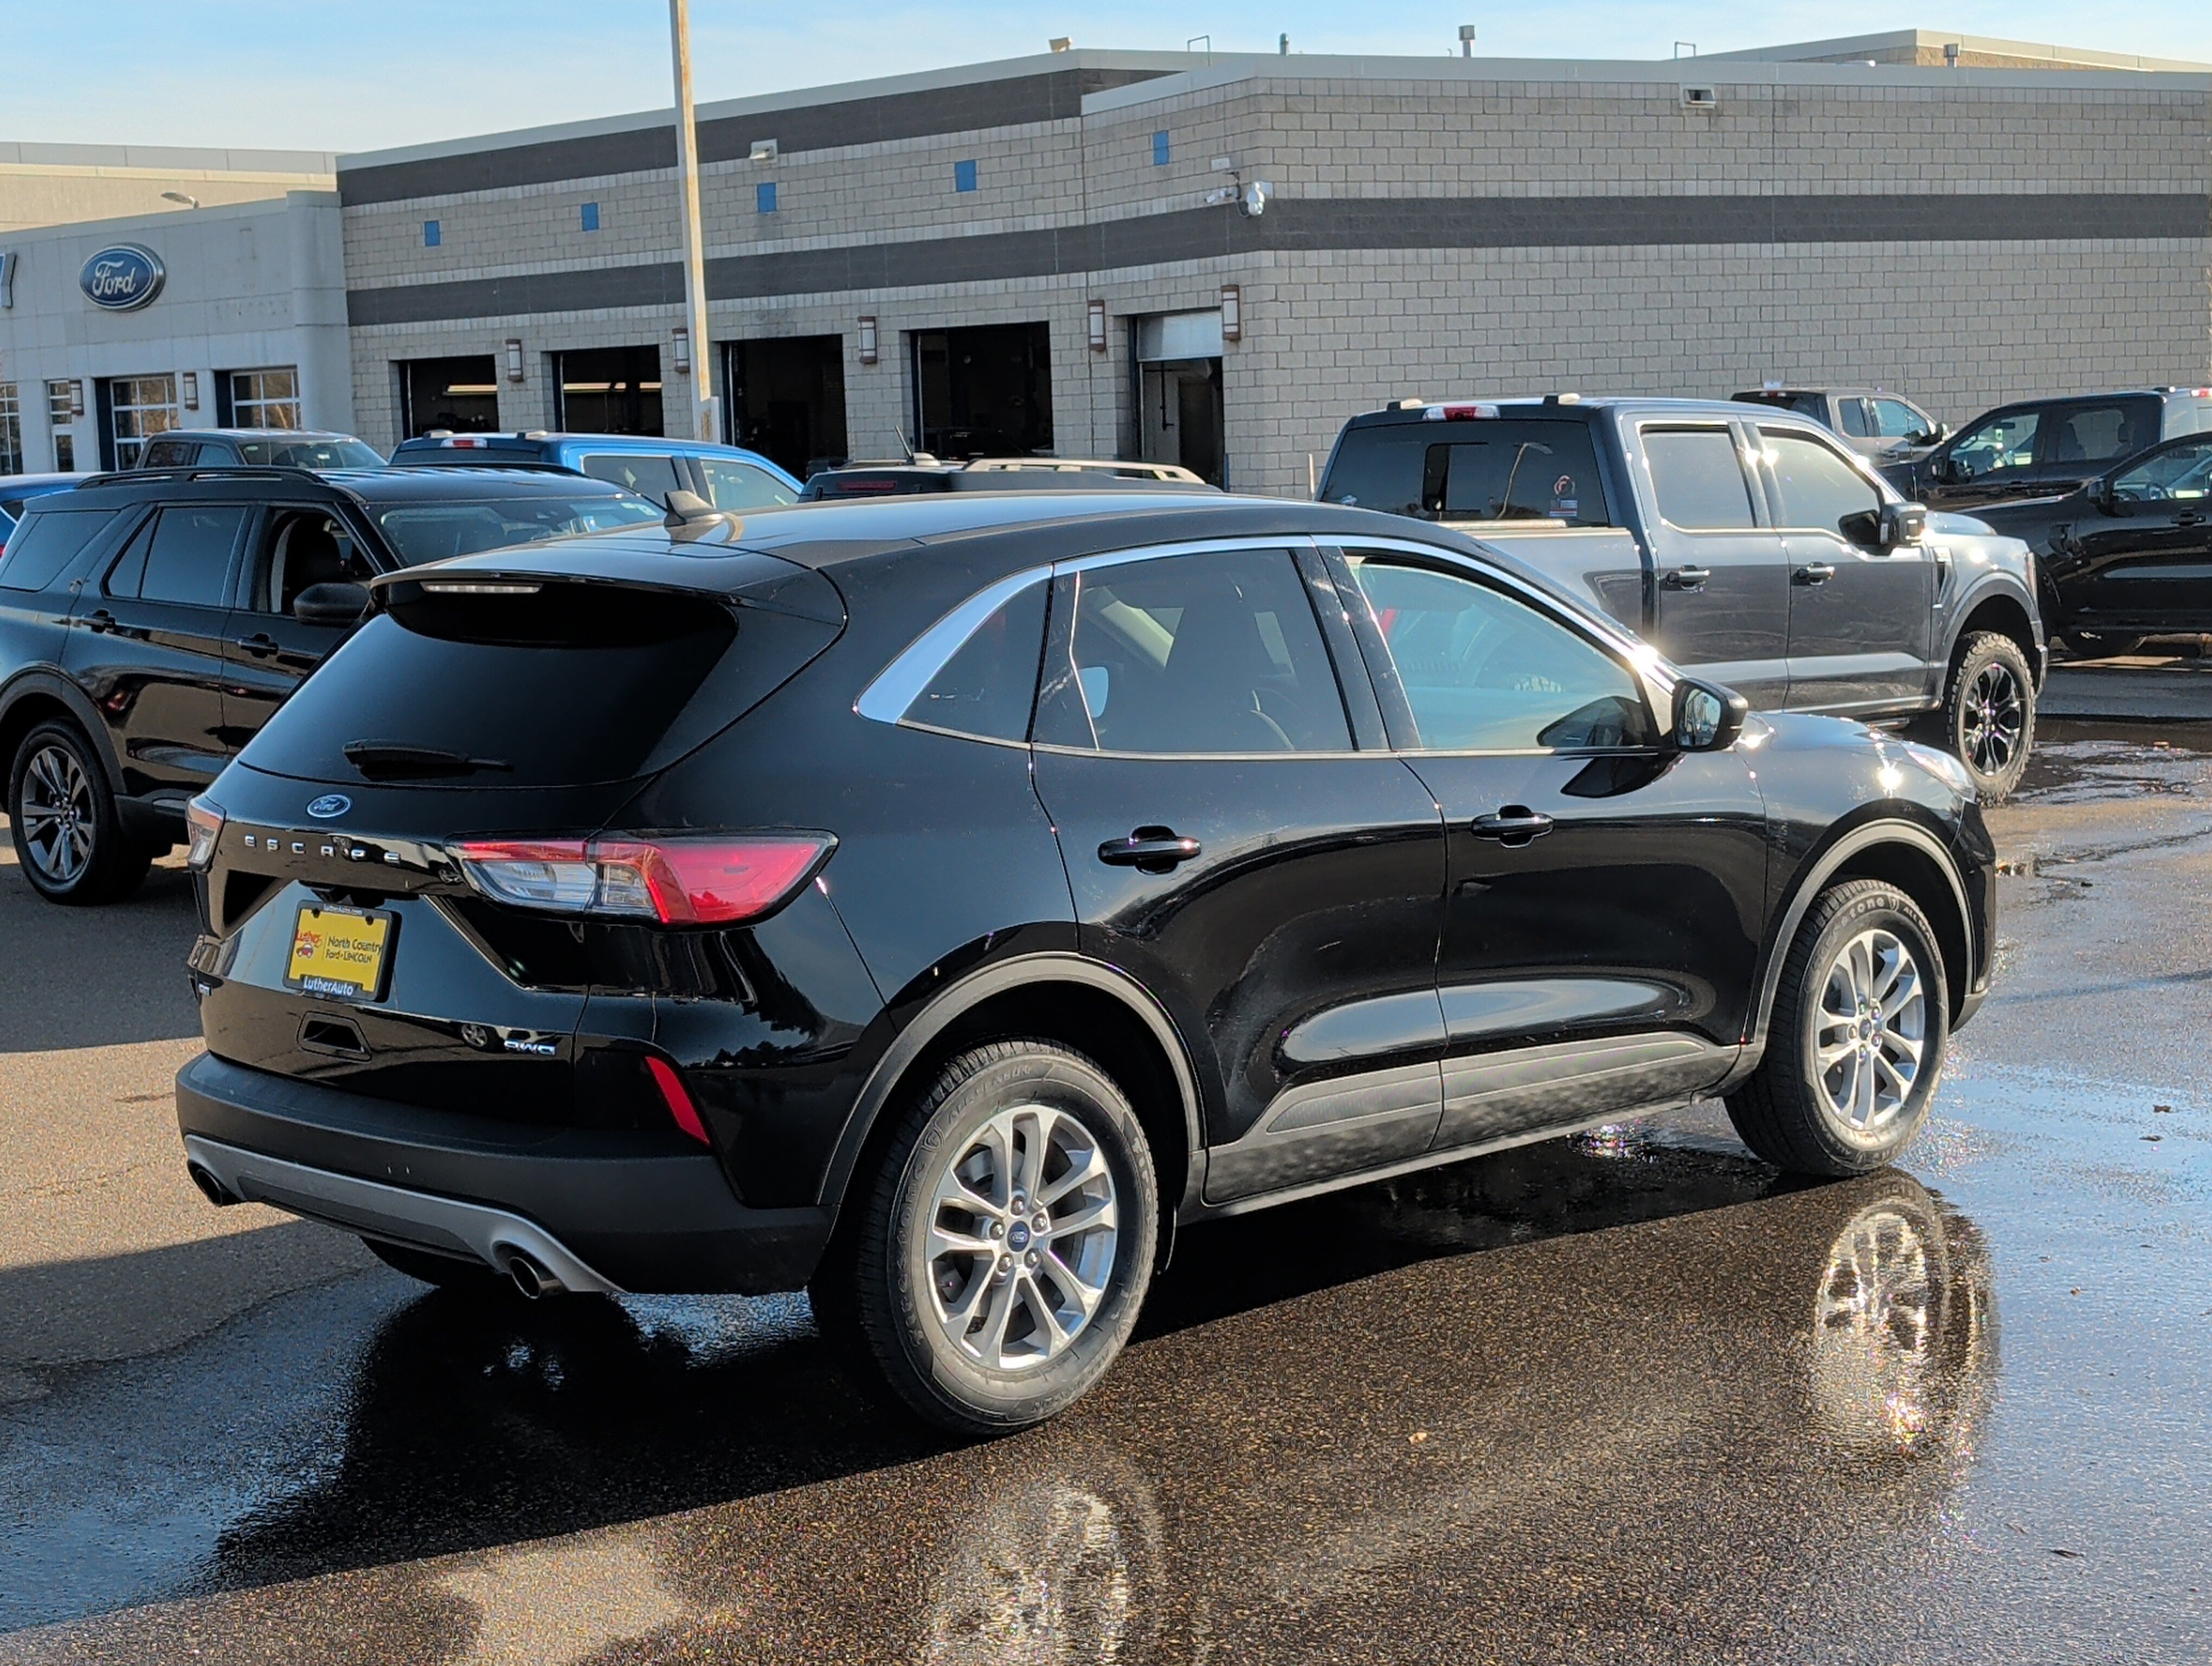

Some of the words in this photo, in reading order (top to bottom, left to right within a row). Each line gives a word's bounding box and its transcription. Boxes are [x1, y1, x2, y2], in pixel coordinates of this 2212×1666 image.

[92, 259, 136, 297] Ford
[244, 835, 401, 864] ESCAPE
[327, 935, 350, 950] North
[352, 938, 381, 956] Country
[303, 976, 353, 996] LutherAuto
[504, 1040, 556, 1055] AWD
